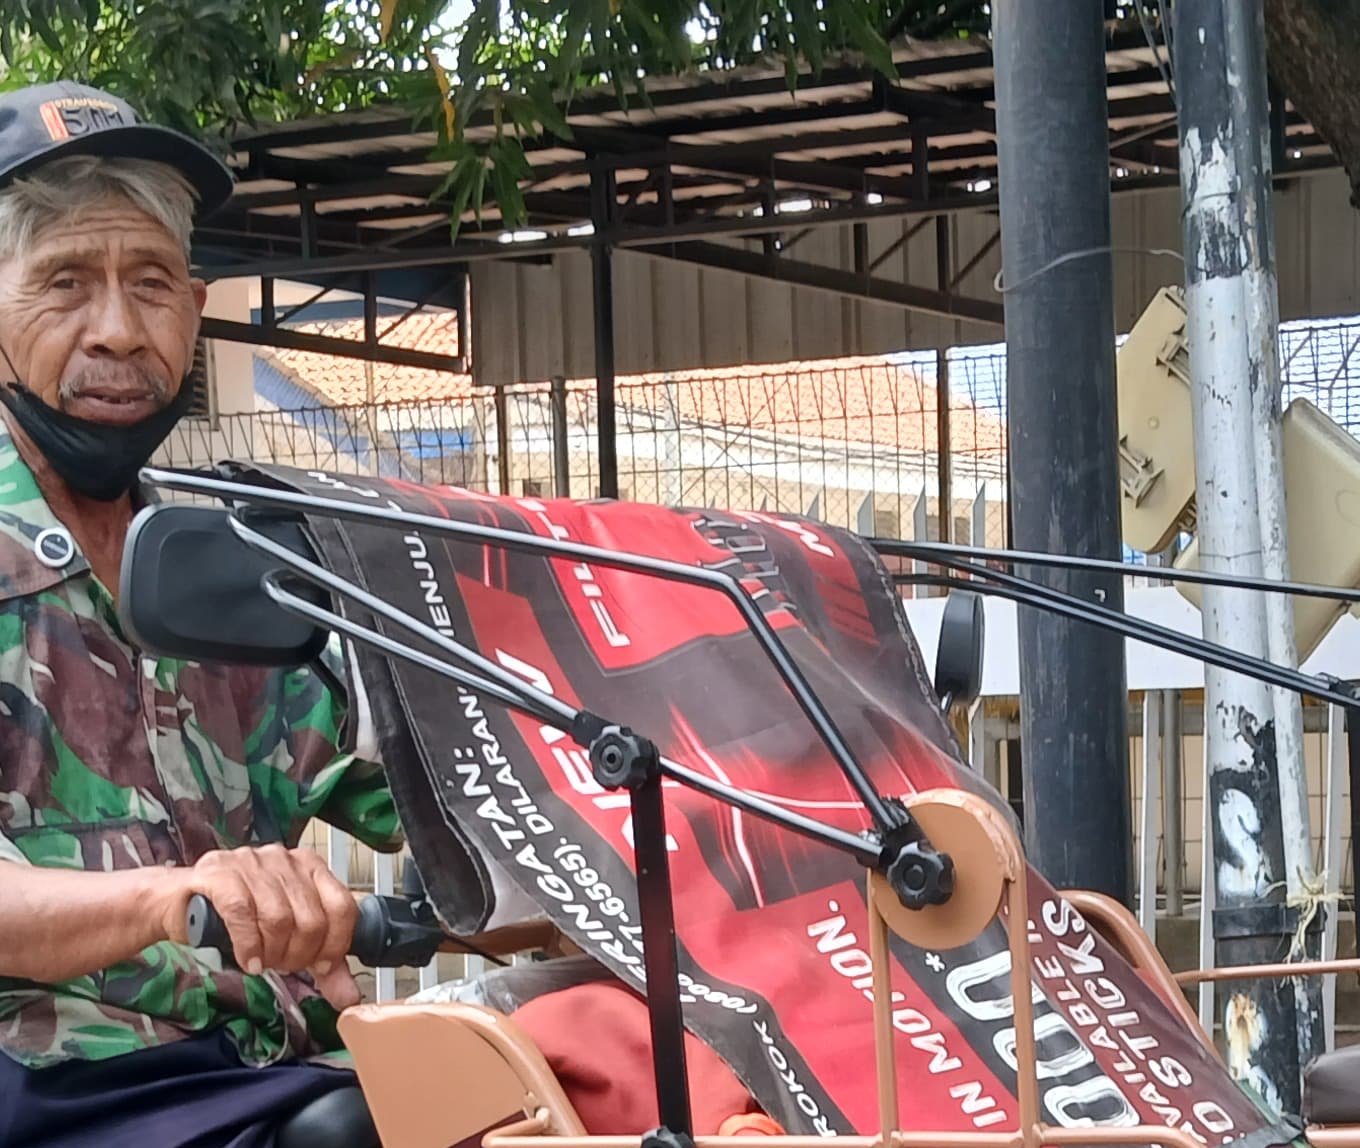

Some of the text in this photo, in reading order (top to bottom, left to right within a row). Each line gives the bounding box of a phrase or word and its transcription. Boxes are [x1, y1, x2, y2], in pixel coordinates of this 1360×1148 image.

[457, 685, 554, 835] DILARAN
[455, 746, 697, 1005] RINGATAN:
[1042, 898, 1193, 1088] STICKS
[949, 1081, 1008, 1128] IN
